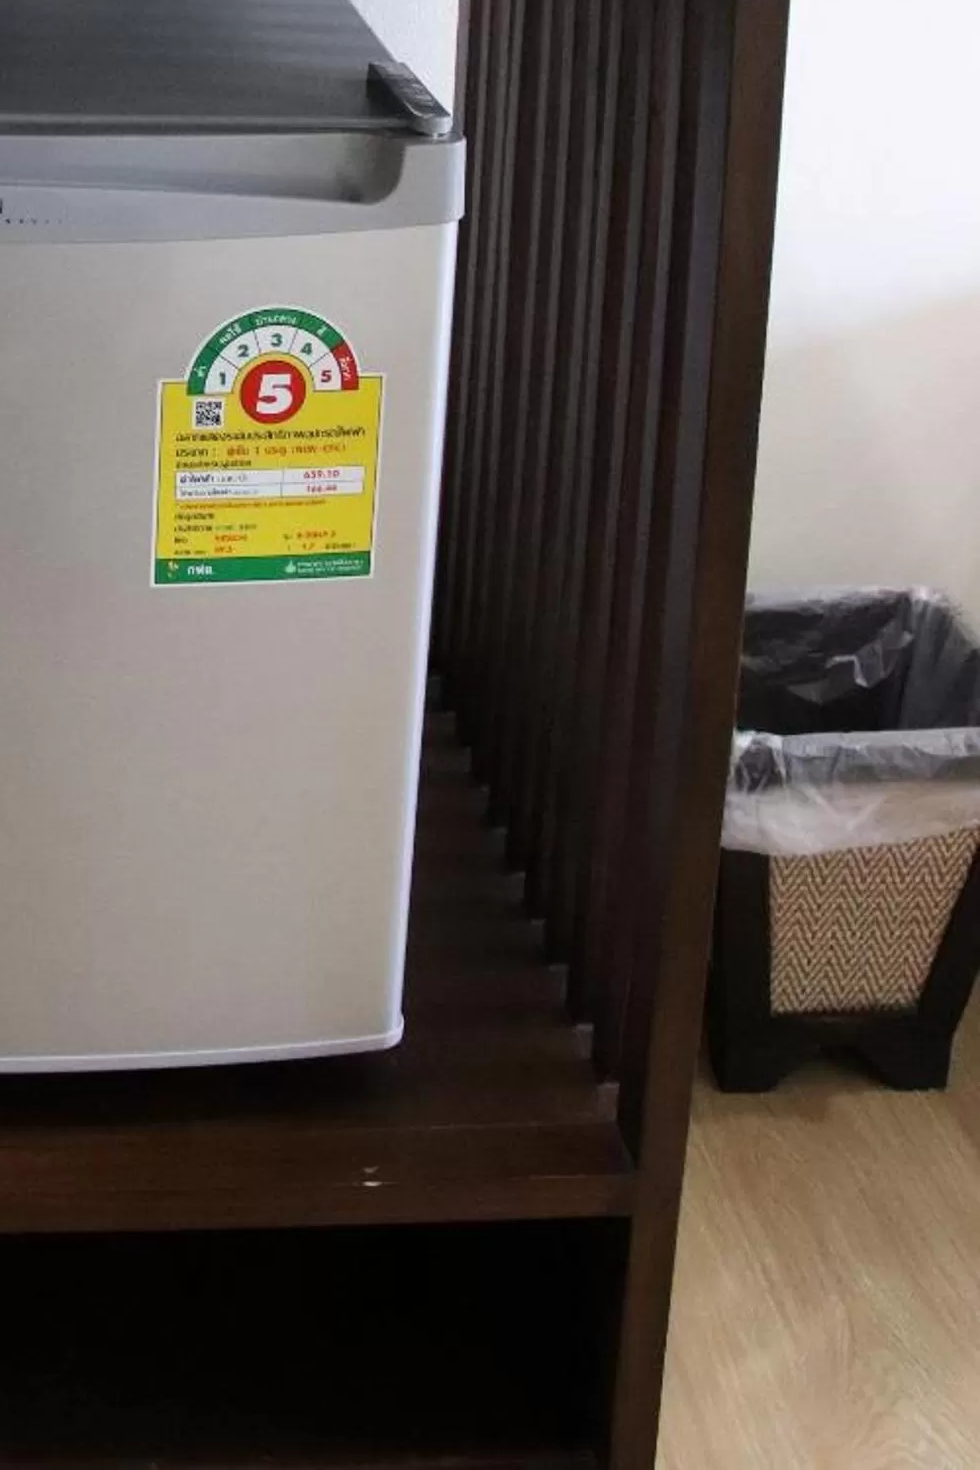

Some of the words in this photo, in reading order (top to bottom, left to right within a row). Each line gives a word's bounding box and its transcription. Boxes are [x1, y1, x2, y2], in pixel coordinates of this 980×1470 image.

[271, 333, 283, 348] 3
[237, 343, 250, 358] 2
[300, 342, 313, 356] 4
[218, 371, 227, 386] 1
[320, 369, 332, 383] 5
[255, 373, 294, 415] 5
